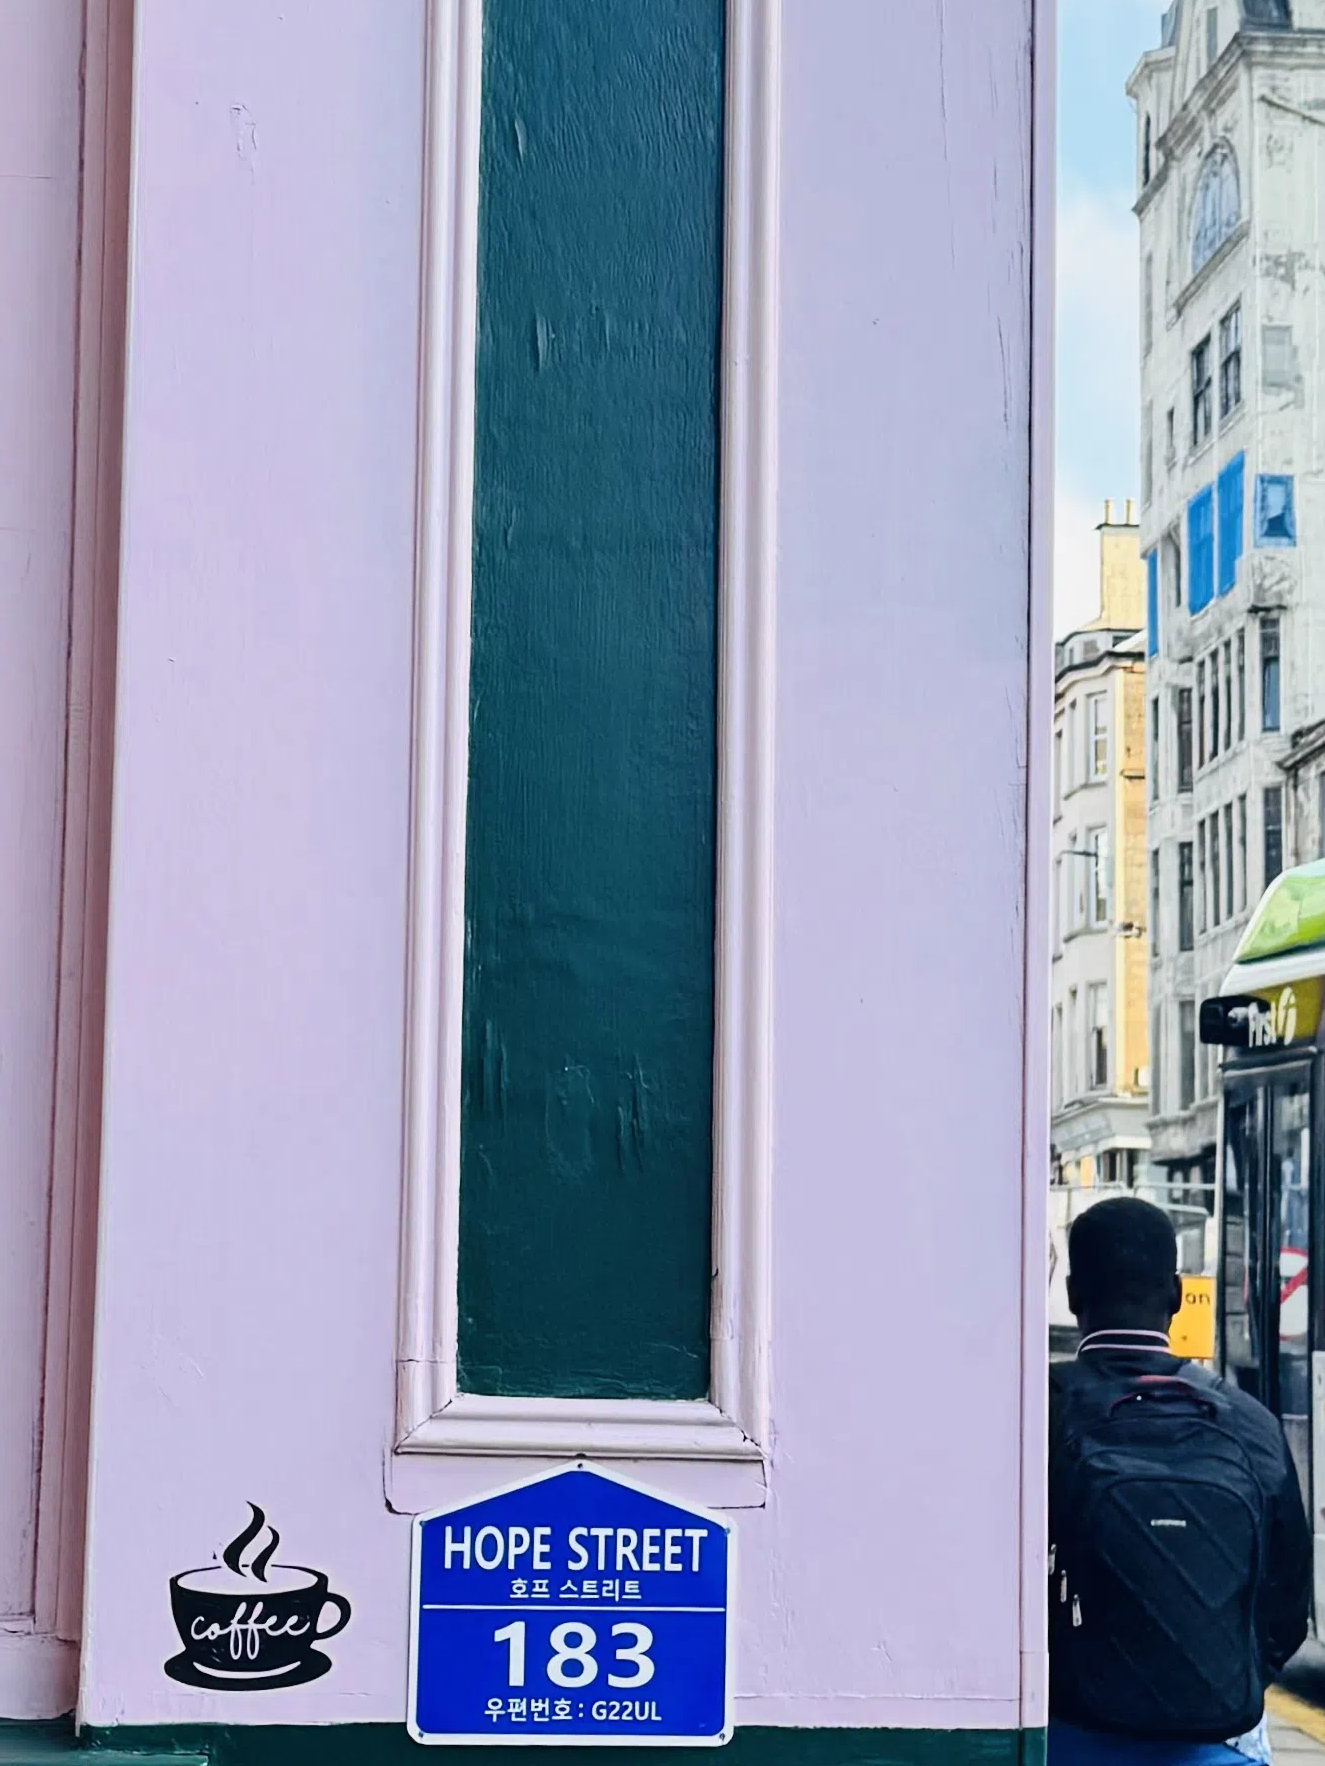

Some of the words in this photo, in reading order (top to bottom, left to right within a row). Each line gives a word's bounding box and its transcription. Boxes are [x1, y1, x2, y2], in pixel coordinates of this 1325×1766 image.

[444, 1525, 552, 1571] HOPE
[567, 1526, 709, 1573] STREET
[509, 1577, 551, 1600] 호프
[558, 1579, 642, 1602] 스트리트
[191, 1602, 310, 1660] coffee
[494, 1620, 656, 1689] 183
[591, 1700, 663, 1722] G22UL
